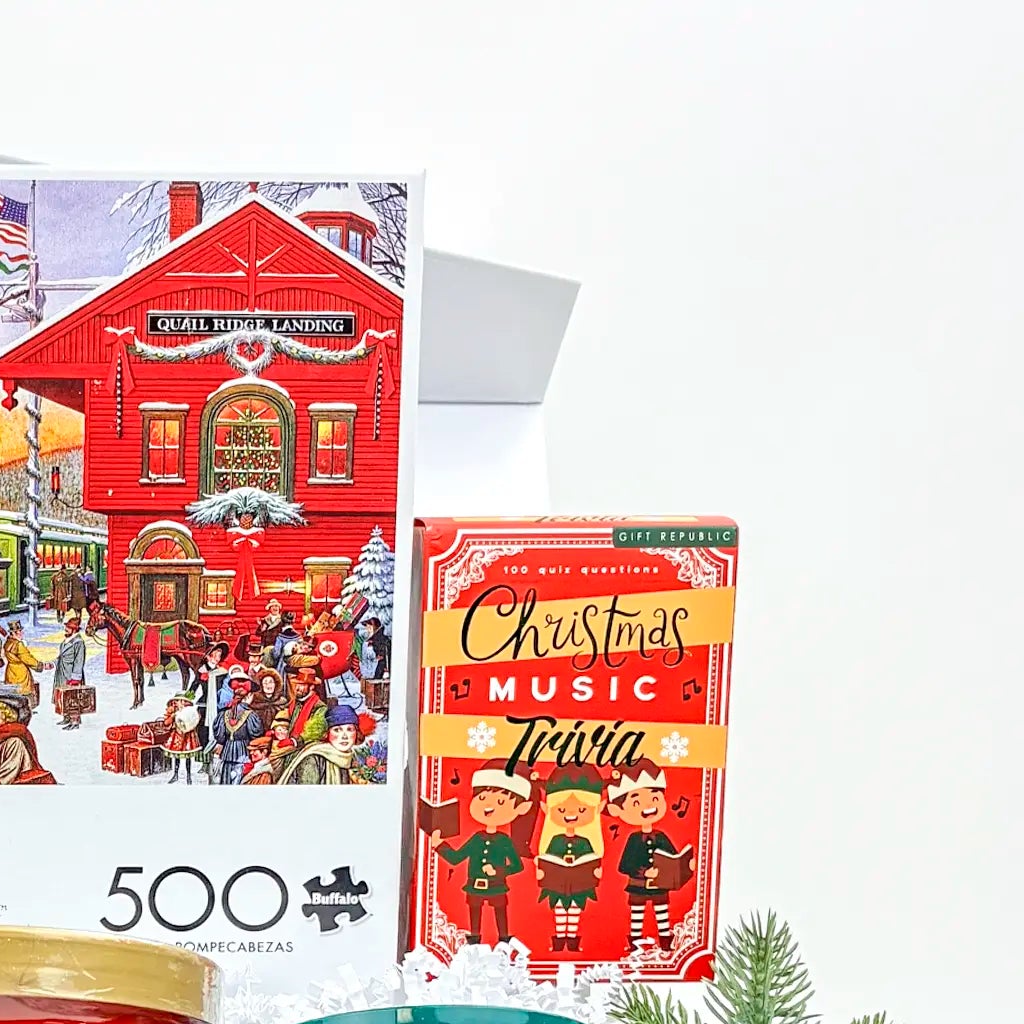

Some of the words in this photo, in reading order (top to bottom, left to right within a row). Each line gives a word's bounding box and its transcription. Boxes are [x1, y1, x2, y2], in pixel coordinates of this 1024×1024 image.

[157, 317, 209, 331] QUAIL
[213, 318, 264, 331] RIDGE
[271, 318, 345, 333] LANDING
[618, 531, 652, 543] GIFT
[660, 531, 732, 543] REPUBLIC
[502, 565, 528, 575] 100
[539, 565, 571, 576] quiz
[580, 565, 660, 575] questions
[461, 584, 690, 671] Christmas
[488, 676, 658, 702] MUSIC
[506, 714, 647, 778] Trivia
[98, 865, 289, 932] 500
[311, 891, 359, 906] Buffalo
